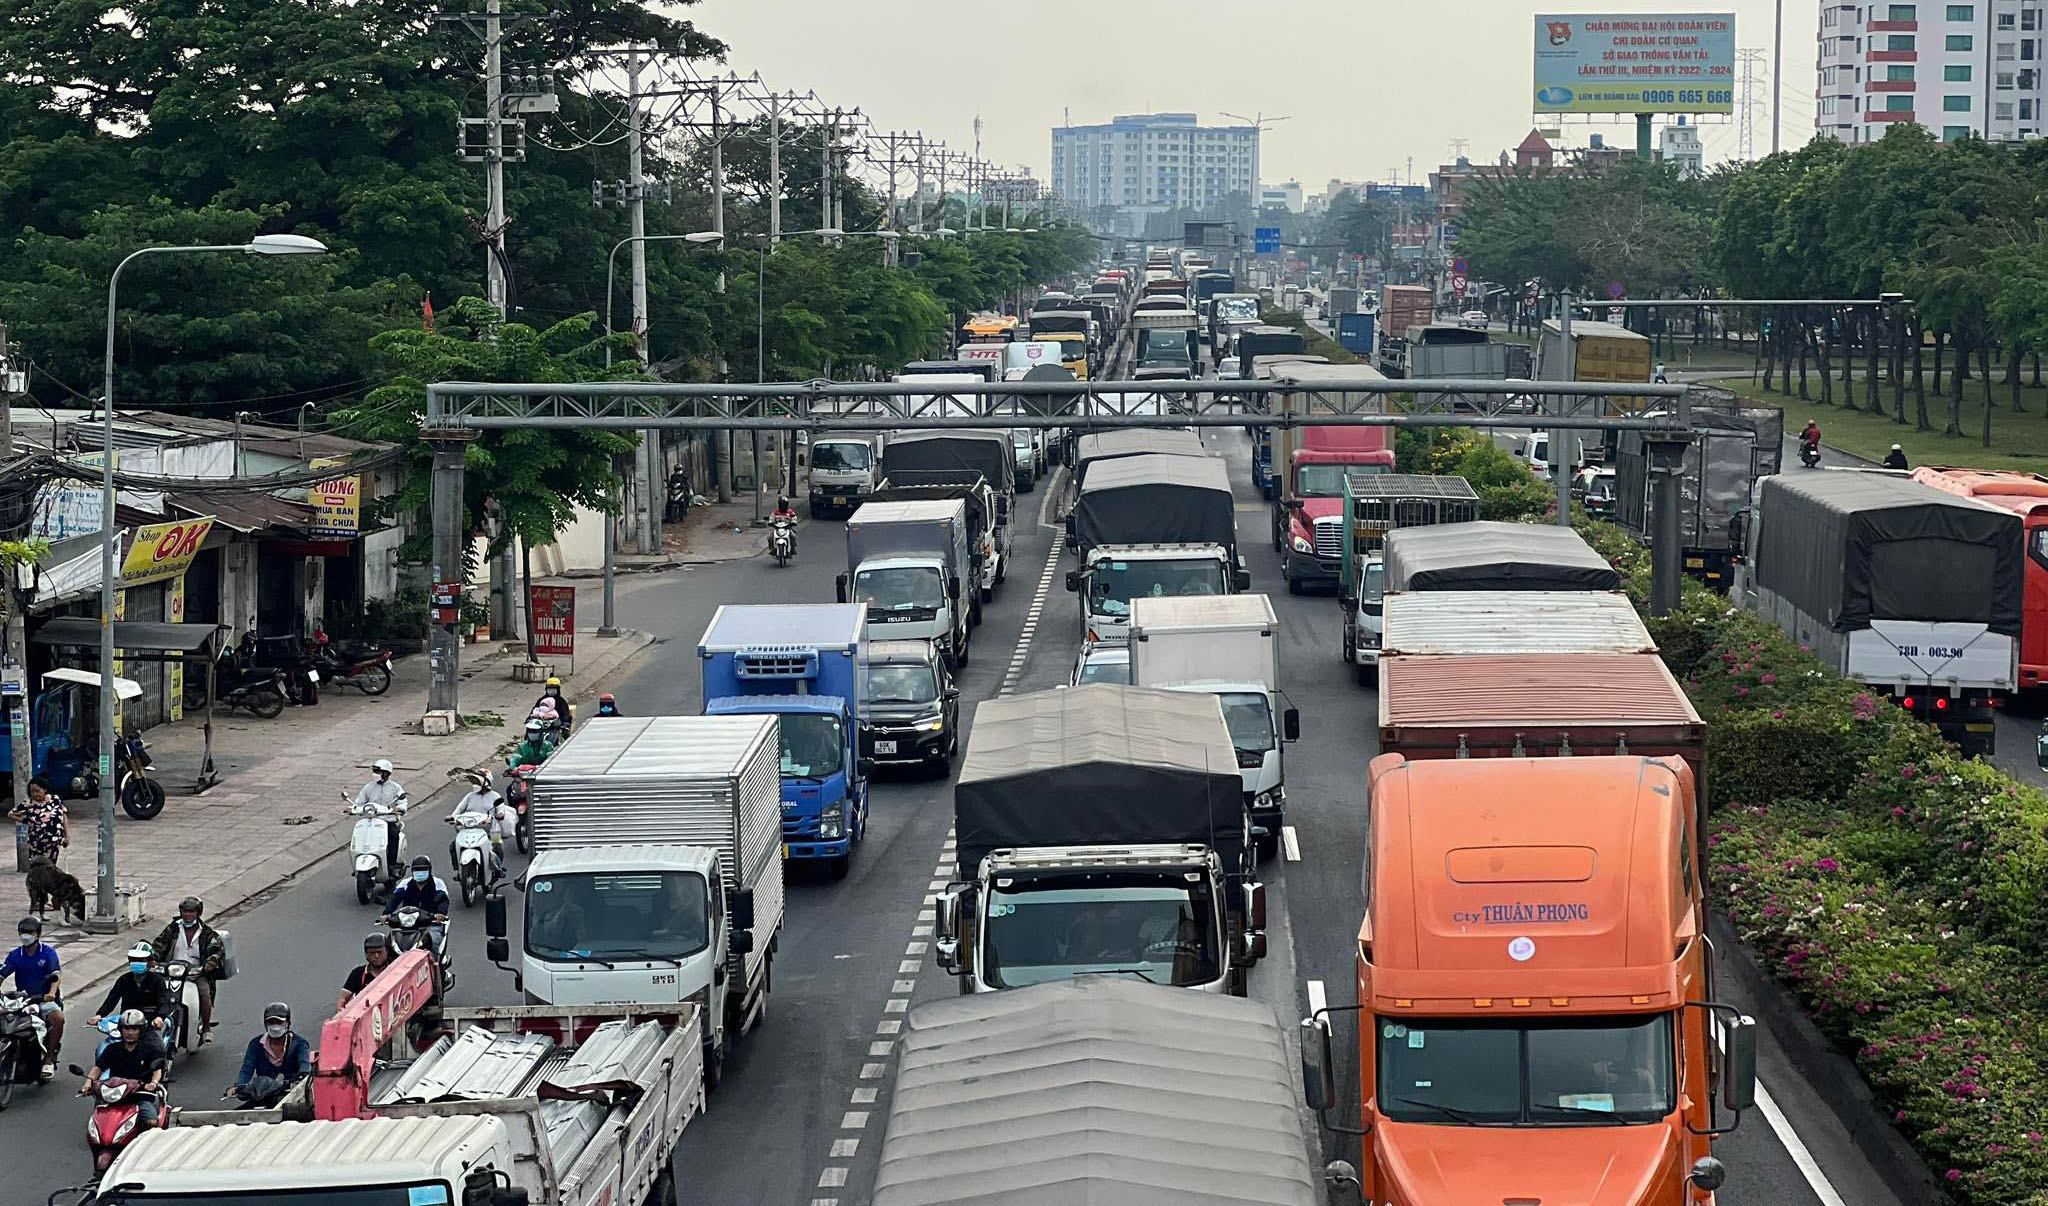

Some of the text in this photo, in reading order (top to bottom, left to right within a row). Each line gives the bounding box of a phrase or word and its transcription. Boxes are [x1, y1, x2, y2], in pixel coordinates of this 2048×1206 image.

[1678, 66, 1700, 75] 2022
[1642, 90, 1674, 103] 0906
[1679, 90, 1703, 103] 665
[1707, 90, 1732, 103] 668
[138, 522, 210, 562] Shop OK
[554, 618, 566, 630] XE
[1453, 912, 1481, 924] Cty
[1536, 903, 1588, 920] PHONG
